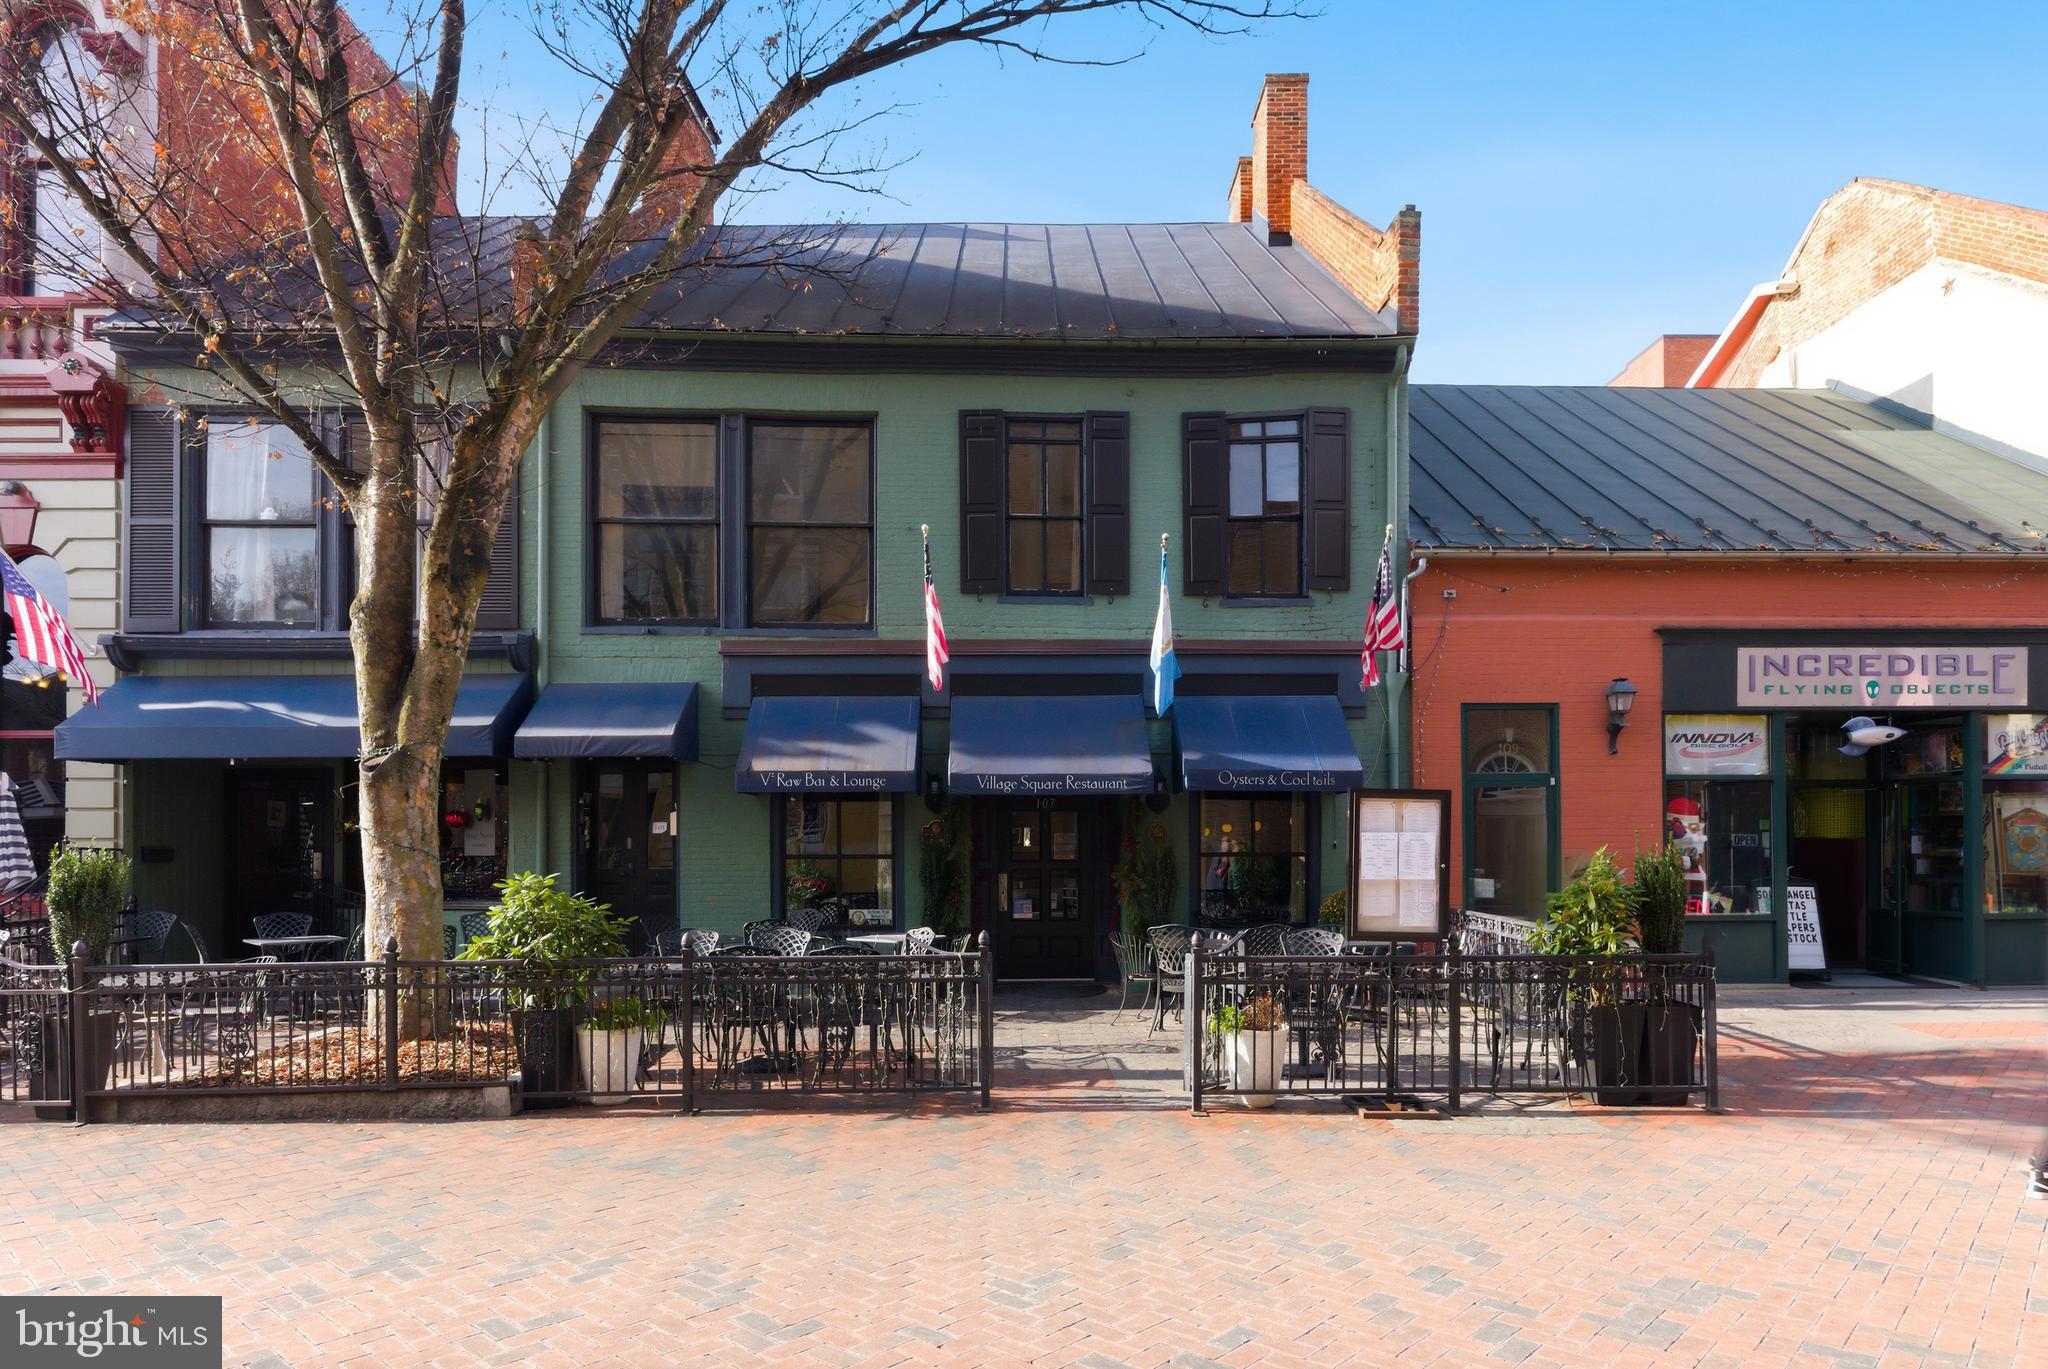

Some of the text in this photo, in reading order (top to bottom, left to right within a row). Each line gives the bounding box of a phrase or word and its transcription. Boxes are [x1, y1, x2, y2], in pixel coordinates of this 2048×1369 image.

[1749, 654, 2016, 695] INCREDIBLE
[1763, 684, 1990, 696] FLYING OBJECTS
[1669, 732, 1754, 744] INNOVA
[777, 772, 802, 787] Raw
[829, 775, 840, 787] &
[843, 772, 887, 790] Lounge
[976, 775, 1128, 793] Village Square Restaurant
[1218, 769, 1265, 788] Oysters
[1267, 774, 1278, 786] &
[1035, 798, 1056, 809] 107
[1734, 834, 1757, 847] OPEN
[1787, 911, 1808, 921] TLE
[1787, 933, 1818, 944] STOCK
